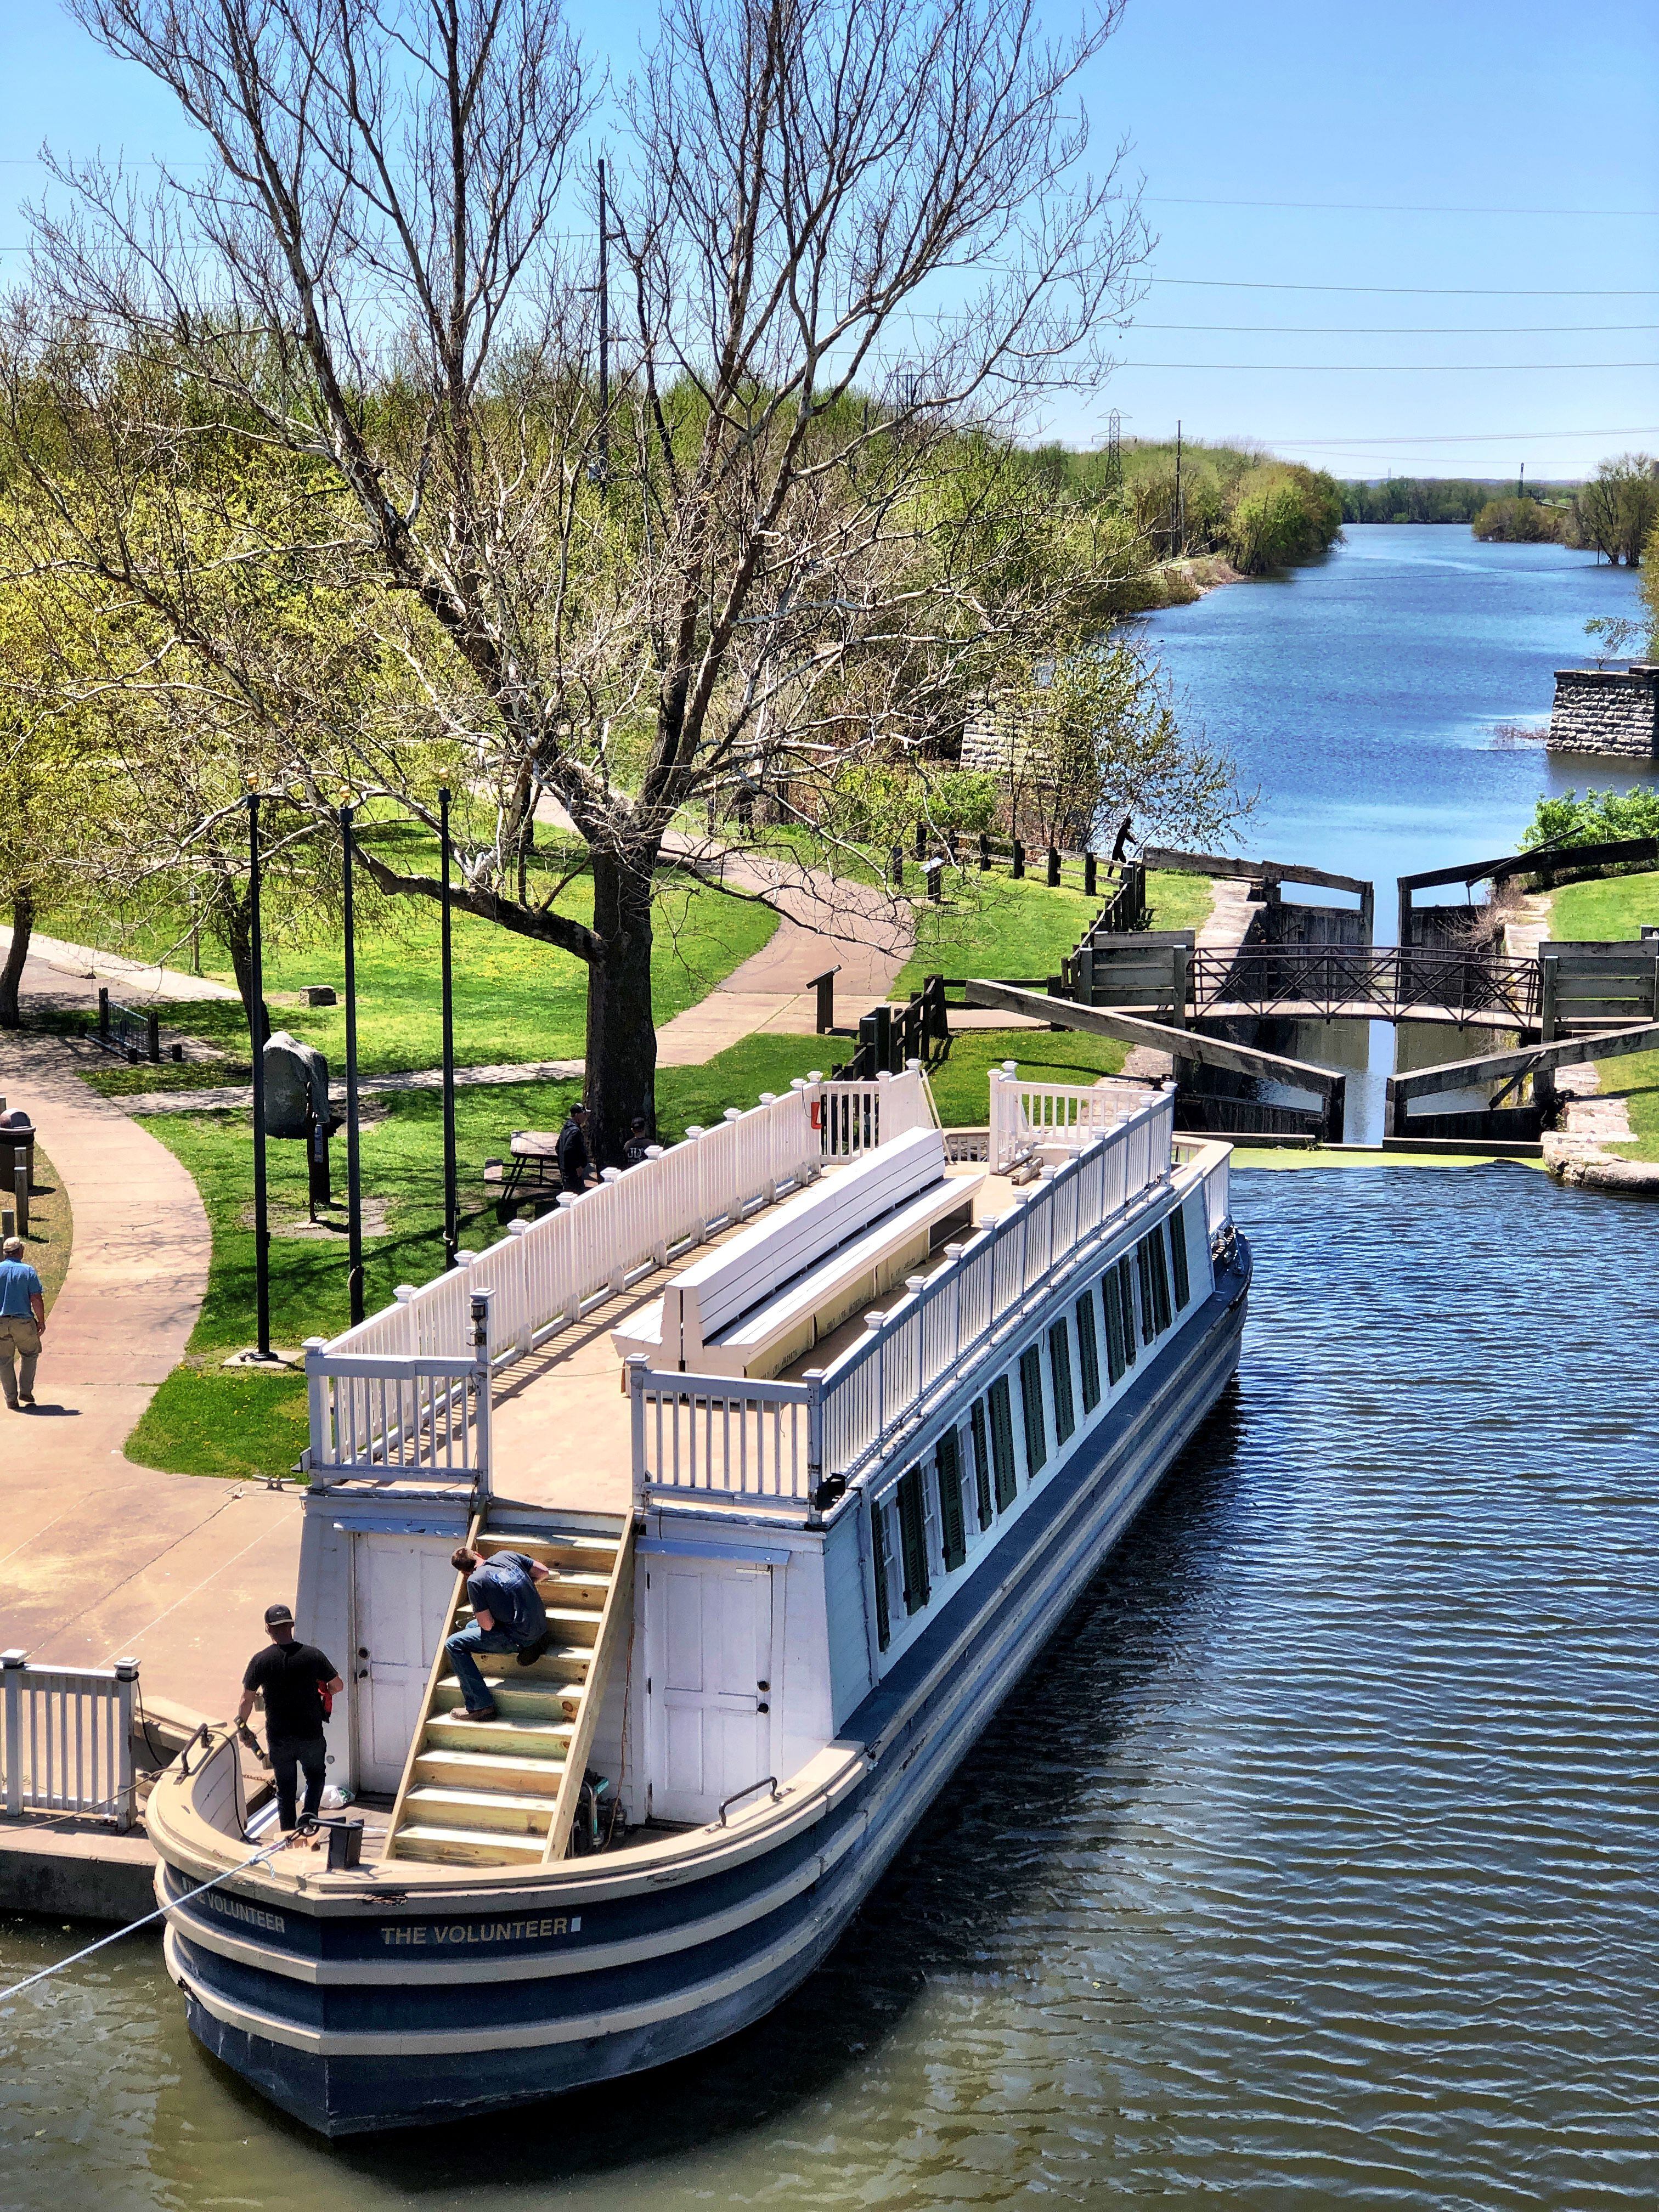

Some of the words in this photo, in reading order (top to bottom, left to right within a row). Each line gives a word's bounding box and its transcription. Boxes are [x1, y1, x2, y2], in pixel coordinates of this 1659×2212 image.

[207, 1891, 285, 1933] VOLUNTEER
[381, 1927, 426, 1944] THE
[434, 1917, 567, 1943] VOLUNTEER
